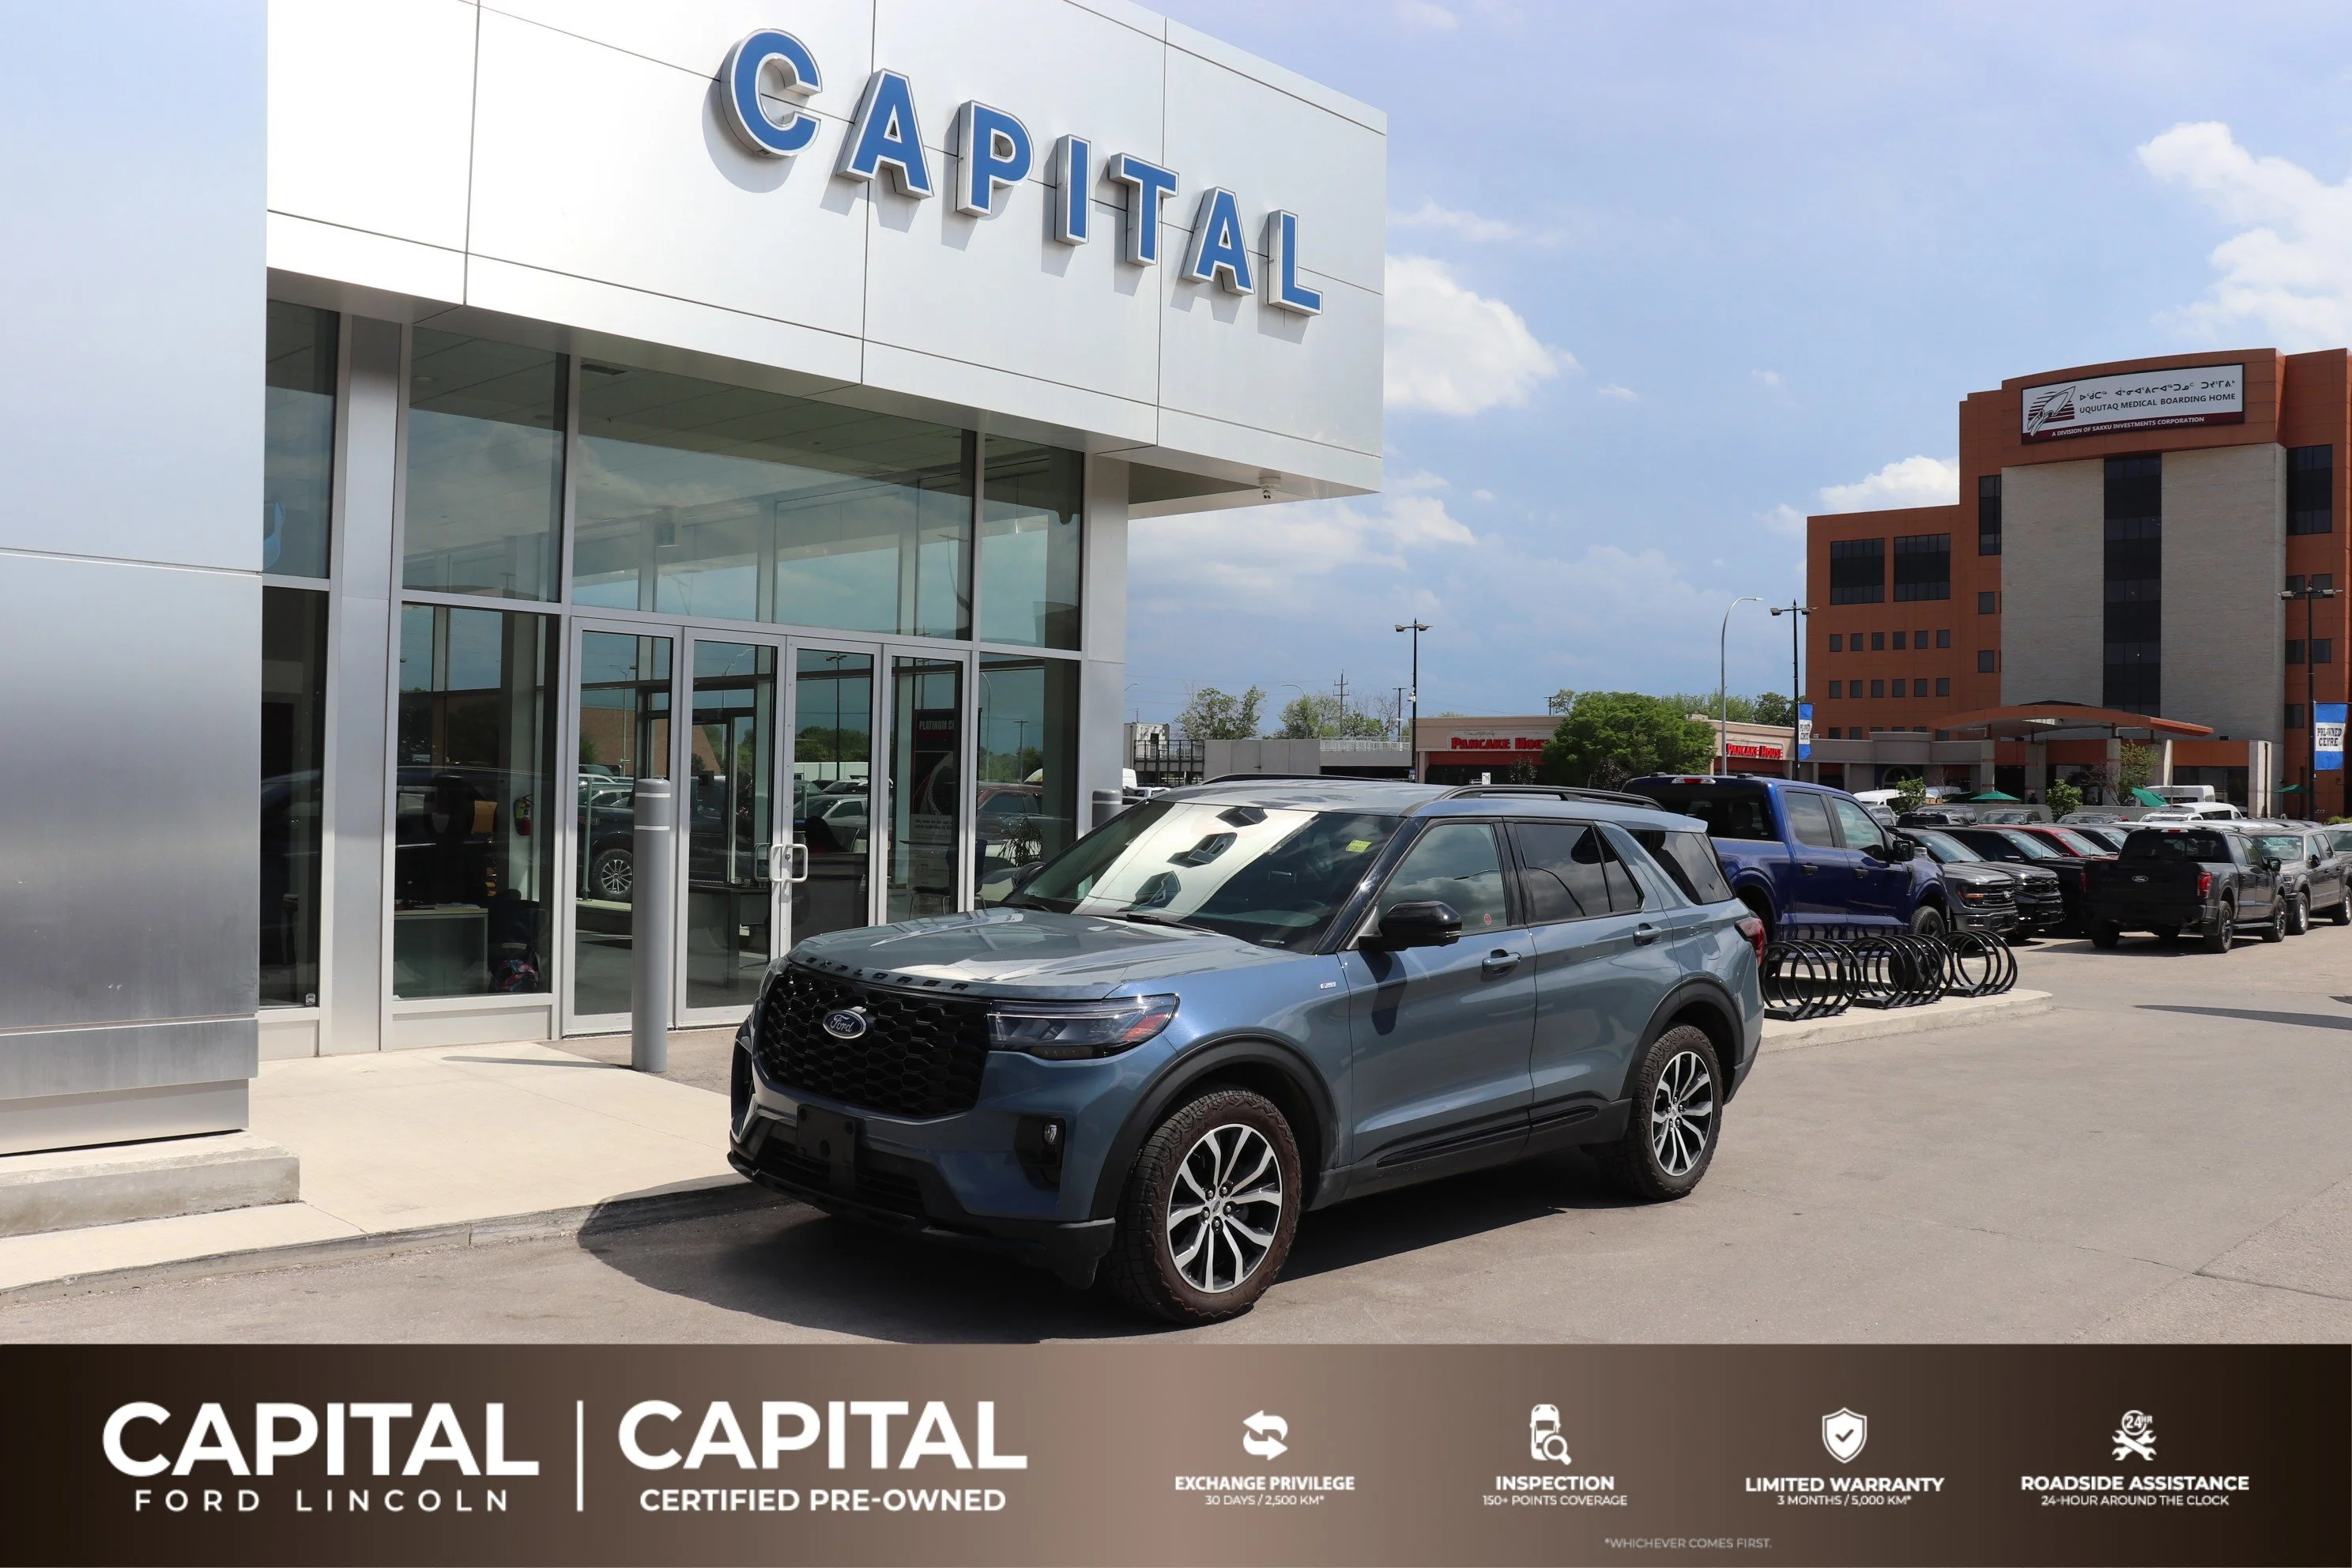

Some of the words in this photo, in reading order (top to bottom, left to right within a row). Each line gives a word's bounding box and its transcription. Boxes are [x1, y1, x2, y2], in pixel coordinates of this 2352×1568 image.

[722, 28, 1323, 315] CAPITAL
[2080, 403, 2118, 413] UQUUTAQ
[2120, 400, 2157, 409] MEDICAL
[2161, 396, 2206, 405] BOARDING
[2113, 420, 2155, 429] INVESTMENTS
[2158, 416, 2204, 425] CORPORATION
[919, 720, 947, 730] PLATINUM
[1451, 737, 1510, 750] PANCAKE
[1515, 737, 1547, 750] HOU
[1726, 743, 1759, 756] PANCAKE
[1759, 746, 1783, 759] HOUSE
[830, 1014, 855, 1033] Ford
